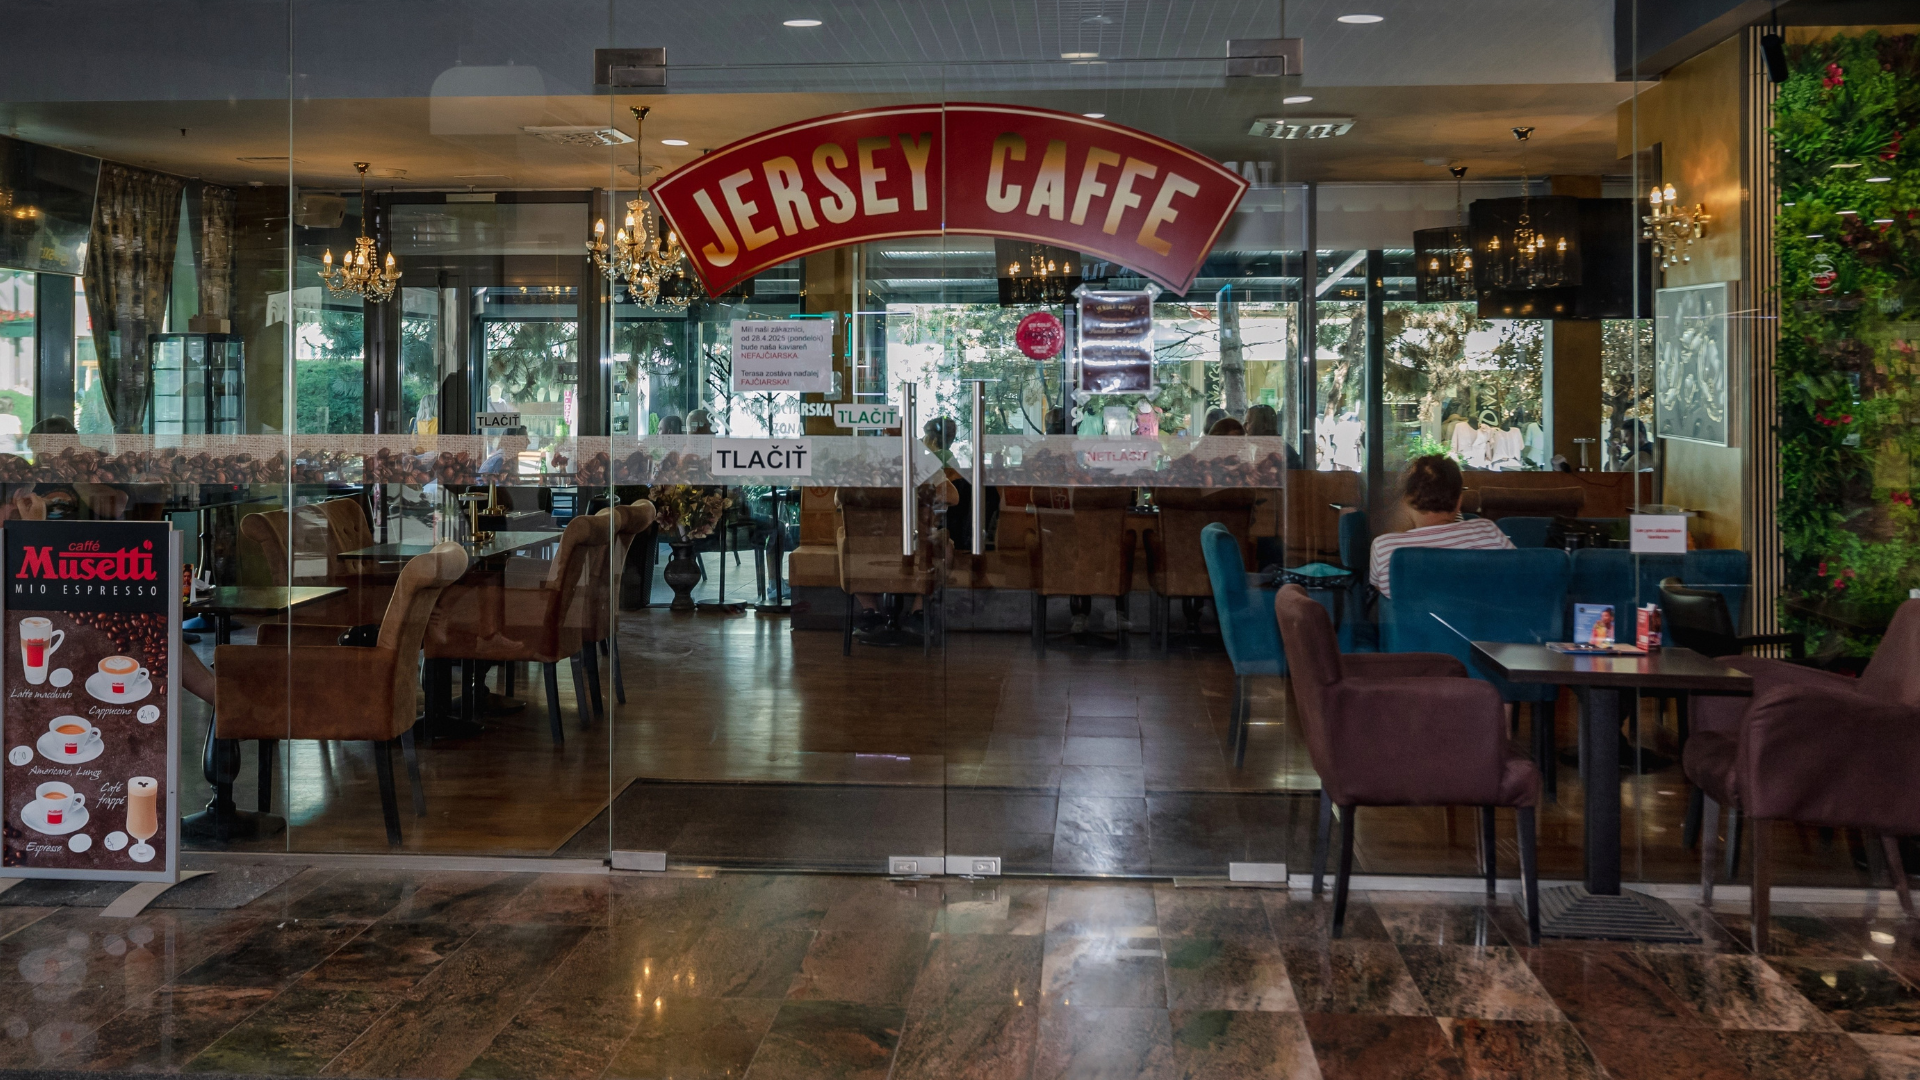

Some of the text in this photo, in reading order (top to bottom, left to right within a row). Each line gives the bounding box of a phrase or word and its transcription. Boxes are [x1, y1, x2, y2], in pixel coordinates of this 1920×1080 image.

[693, 132, 1200, 267] JERSEY CAFFE
[787, 335, 823, 343] (pondelok)
[476, 414, 520, 426] TLAČIŤ
[836, 407, 897, 424] TLAČIŤ
[716, 445, 807, 469] TLAČIŤ
[68, 540, 100, 551] caffé
[15, 540, 158, 581] Musetti
[15, 584, 157, 596] MIO ESPRESSO
[10, 688, 73, 699] Latte macchiato
[88, 705, 133, 720] Cappuccino
[28, 765, 102, 781] Americano, Lungo
[100, 781, 124, 797] Café
[96, 794, 128, 811] frappé
[26, 841, 63, 857] Espresso
